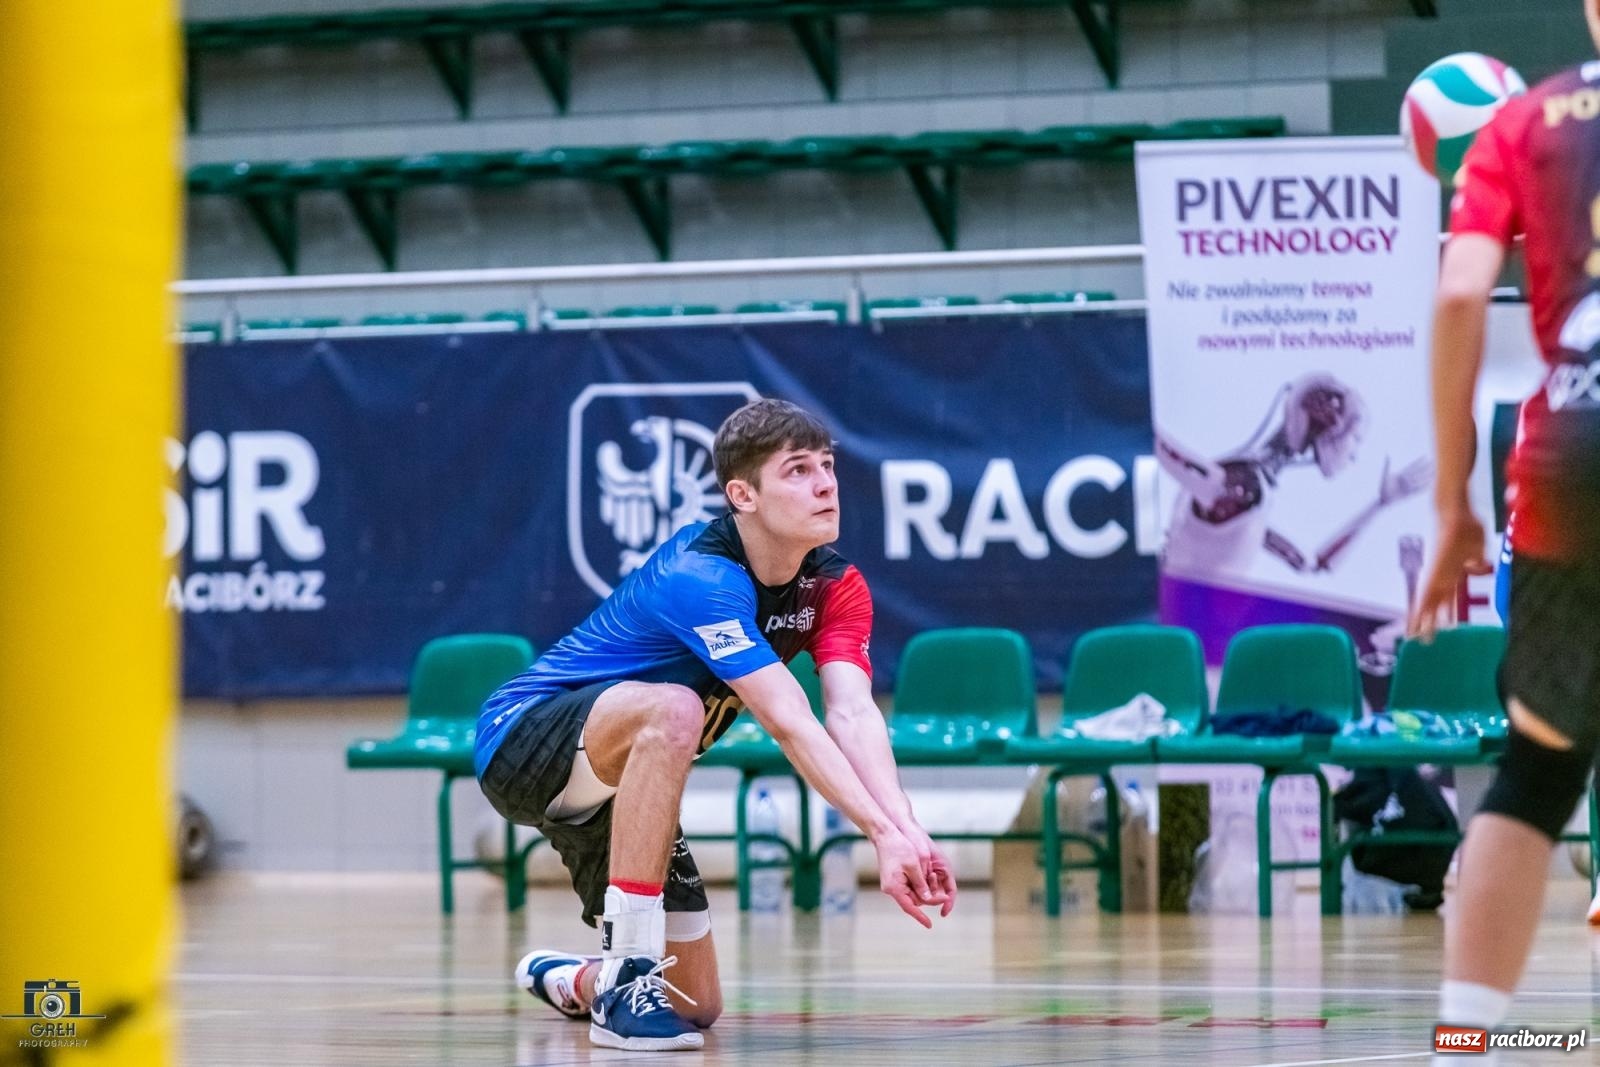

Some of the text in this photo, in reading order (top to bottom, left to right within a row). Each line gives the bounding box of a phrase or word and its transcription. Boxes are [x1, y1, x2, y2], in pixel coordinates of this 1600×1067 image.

[1175, 174, 1400, 223] PIVEXIN
[1178, 226, 1399, 256] TECHNOLOGY
[1167, 279, 1373, 301] Nie zwalniamy tempa
[1232, 305, 1330, 327] podążamy
[1335, 311, 1358, 324] za
[1197, 326, 1415, 353] nowymi technologiami
